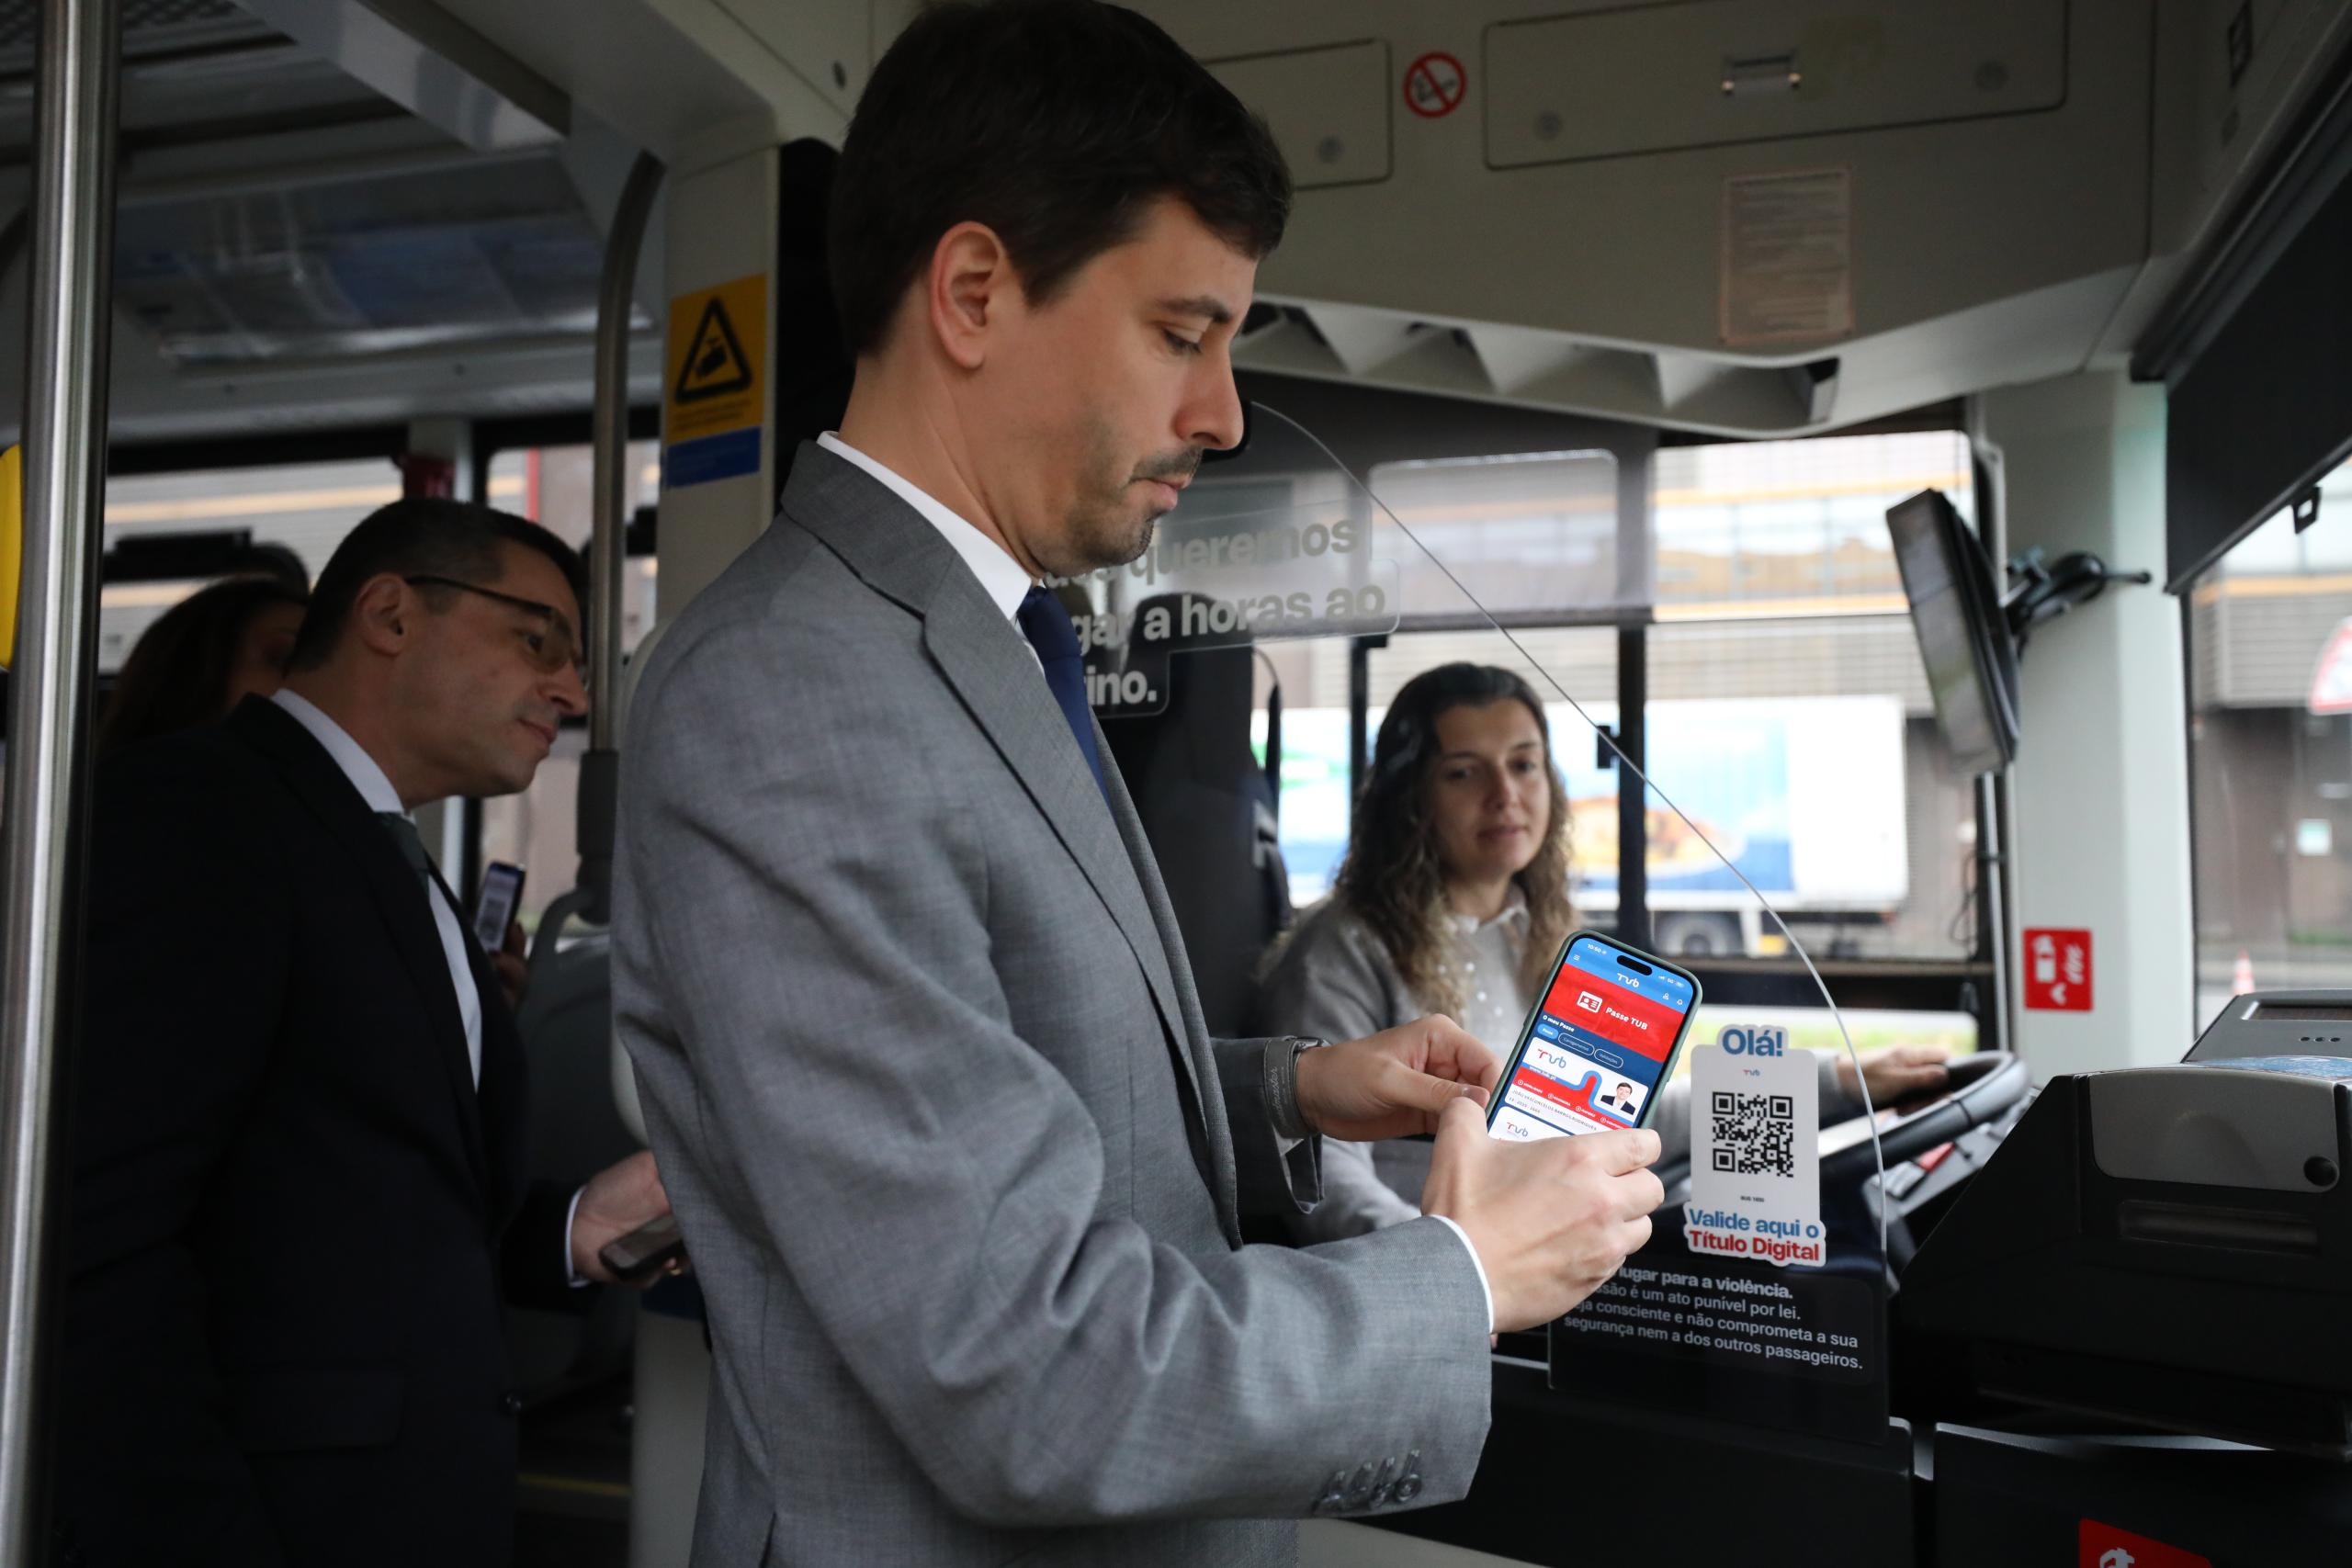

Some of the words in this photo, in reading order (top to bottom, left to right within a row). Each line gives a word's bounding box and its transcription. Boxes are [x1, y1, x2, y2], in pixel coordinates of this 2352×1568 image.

[1129, 519, 1358, 585] queremos
[1144, 606, 1170, 640] a
[1182, 592, 1313, 637] horas
[1326, 584, 1385, 622] ao
[1559, 1021, 1575, 1032] Passe
[1605, 1007, 1629, 1022] Passe
[1631, 1017, 1648, 1030] TUB
[1722, 1029, 1783, 1056] Olá!
[1690, 1209, 1750, 1231] Valide
[1756, 1219, 1801, 1238] aqui
[1805, 1224, 1819, 1238] o
[1690, 1231, 1747, 1252] Título
[1752, 1237, 1819, 1261] Digital
[1619, 1267, 1658, 1282] lugar
[1661, 1271, 1699, 1287] para
[1702, 1278, 1713, 1289] a
[1715, 1277, 1793, 1299] violência.
[1630, 1284, 1639, 1299] é
[1642, 1290, 1664, 1302] um
[1668, 1292, 1690, 1305] ato
[1694, 1295, 1746, 1313] punível
[1750, 1303, 1775, 1316] por
[1779, 1303, 1801, 1320] lei.
[1596, 1302, 1670, 1321] consciente
[1674, 1314, 1683, 1324] e
[1687, 1313, 1714, 1327] não
[1717, 1319, 1813, 1342] comprometa
[1816, 1332, 1826, 1344] a
[1830, 1334, 1859, 1348] sua
[1564, 1315, 1634, 1337] segurança
[1637, 1326, 1668, 1340] nem
[1671, 1331, 1680, 1342] a
[1684, 1331, 1711, 1347] dos
[1714, 1337, 1762, 1354] outros
[1765, 1345, 1863, 1370] passageiros.
